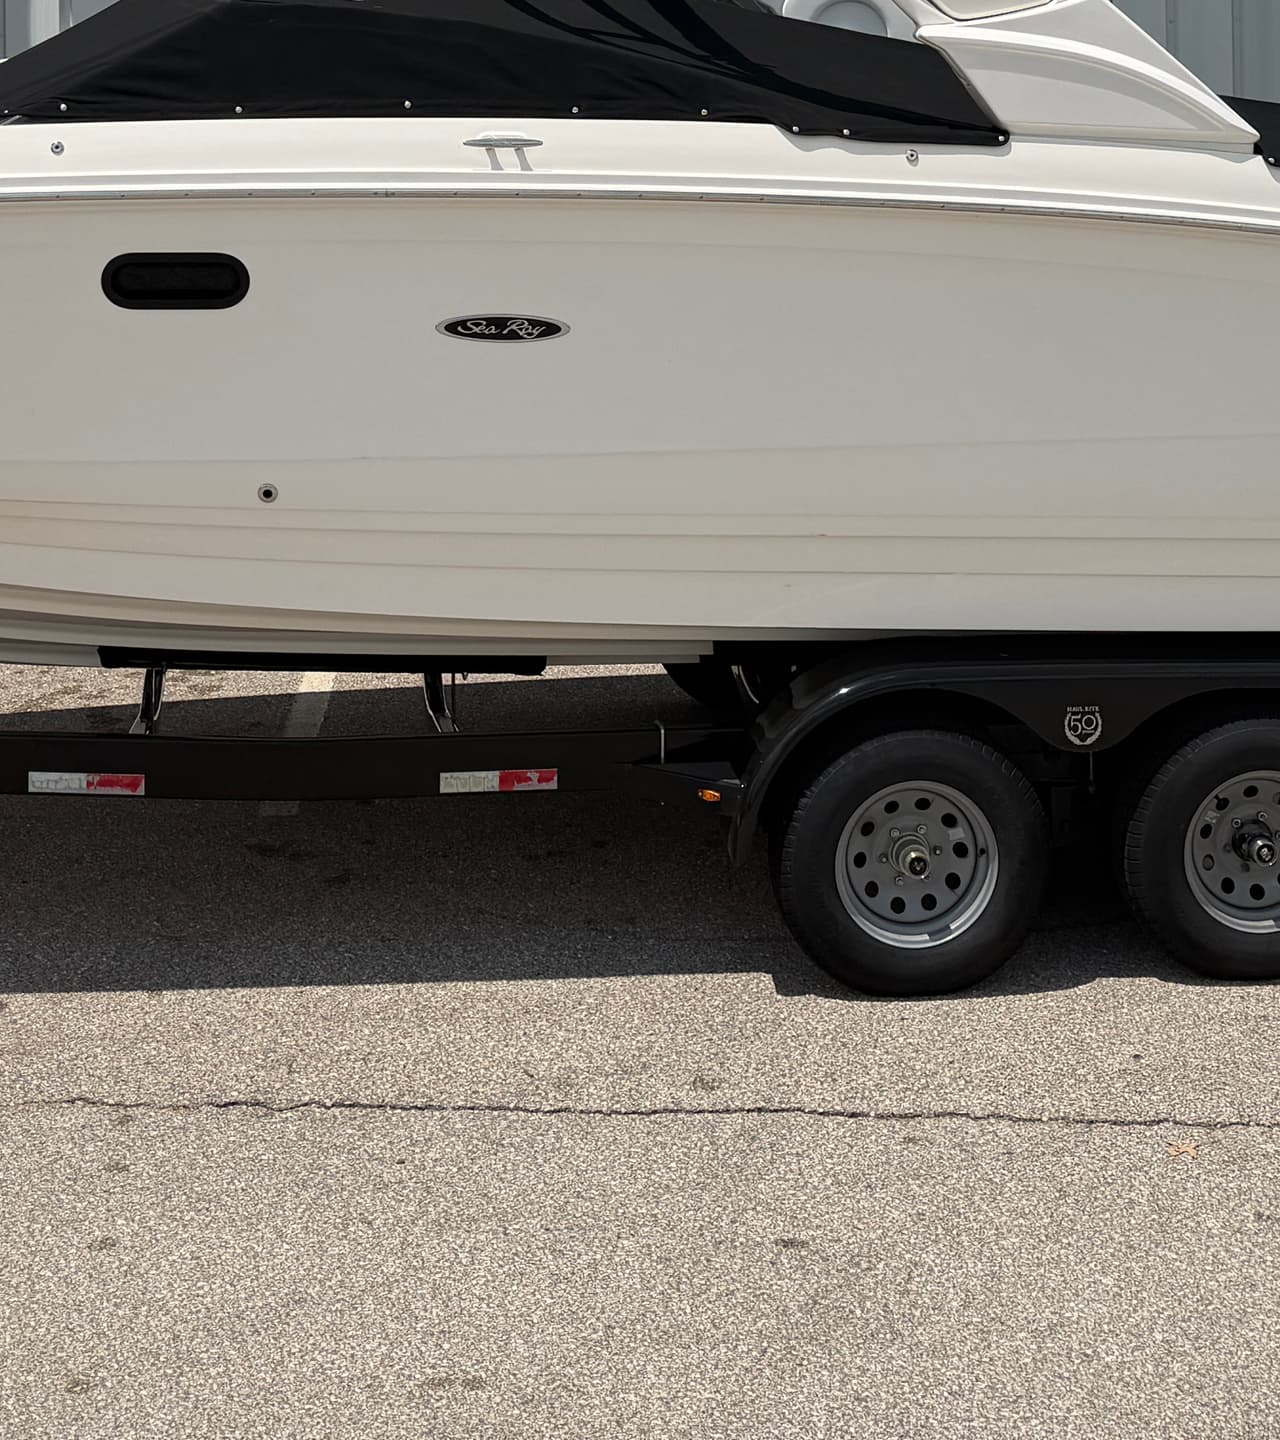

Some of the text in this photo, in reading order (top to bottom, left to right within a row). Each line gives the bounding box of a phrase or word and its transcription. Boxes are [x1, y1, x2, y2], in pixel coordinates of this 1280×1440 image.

[457, 319, 546, 339] Sea Ray
[1070, 712, 1096, 736] 50
